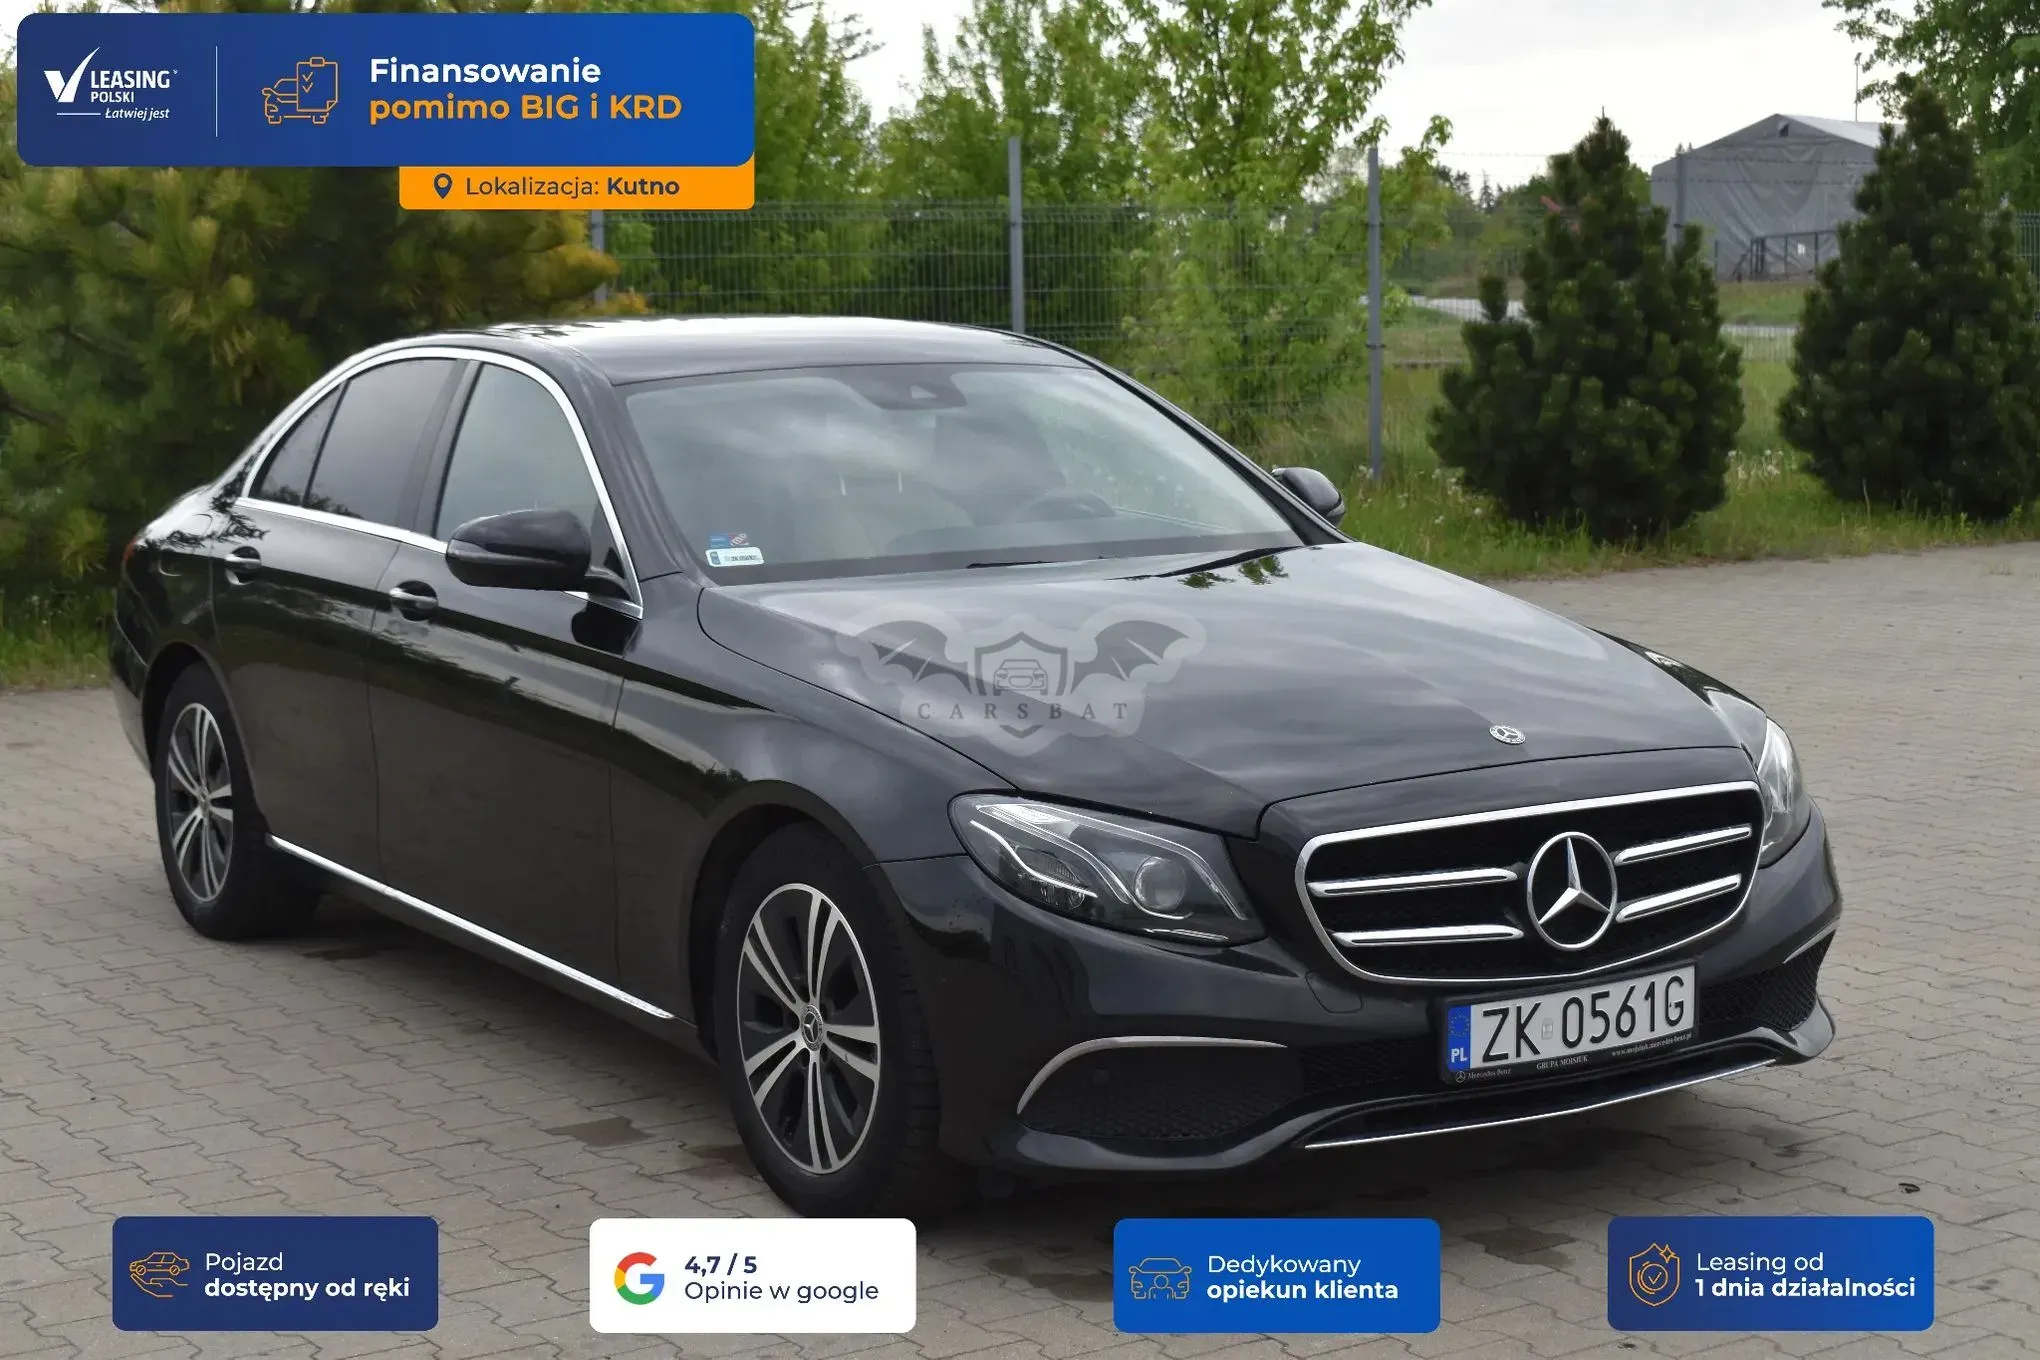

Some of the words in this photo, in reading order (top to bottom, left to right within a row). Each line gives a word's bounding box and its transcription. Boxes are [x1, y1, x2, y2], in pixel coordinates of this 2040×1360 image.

[1482, 1002, 1542, 1063] ZK
[1562, 976, 1684, 1048] 0561G
[1451, 1048, 1468, 1064] PL
